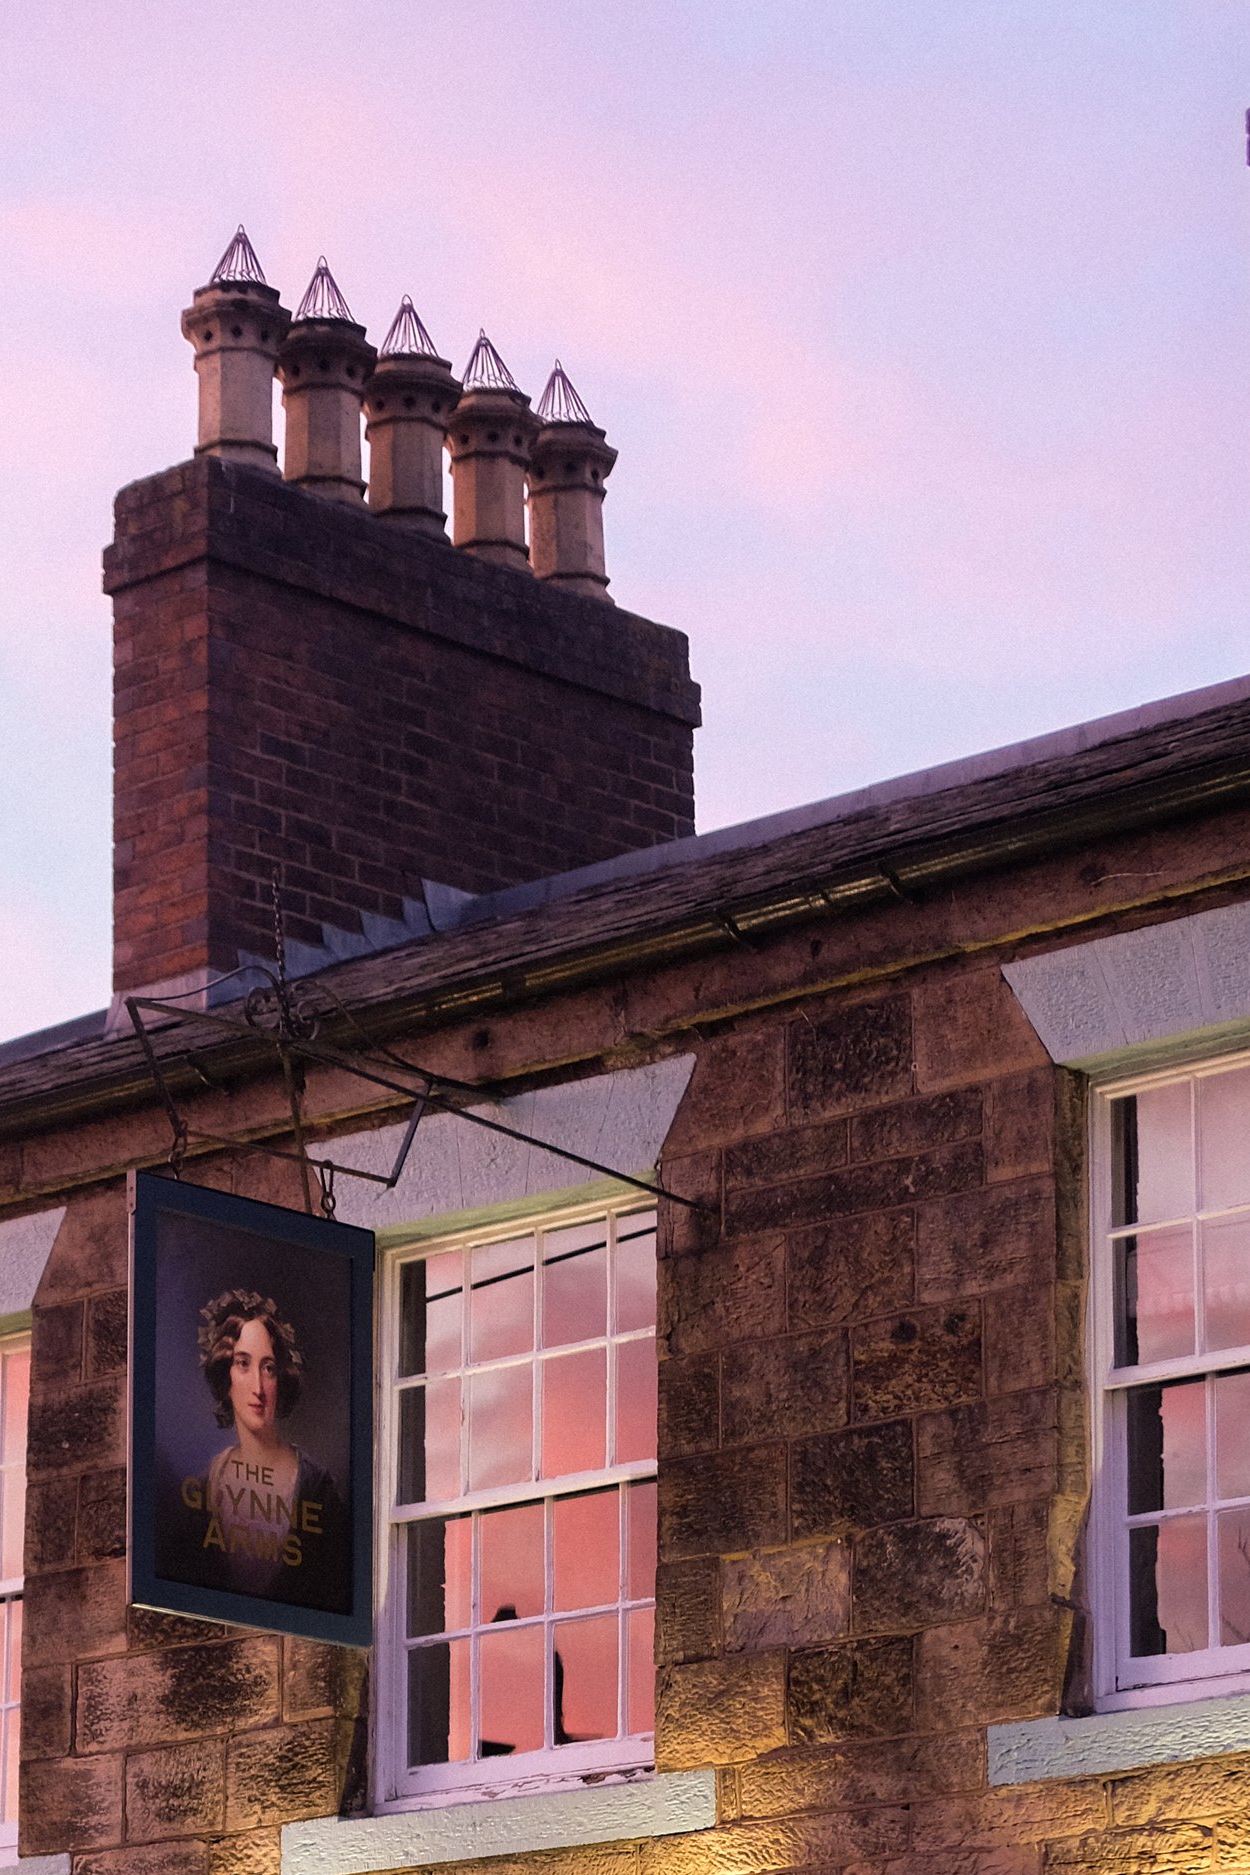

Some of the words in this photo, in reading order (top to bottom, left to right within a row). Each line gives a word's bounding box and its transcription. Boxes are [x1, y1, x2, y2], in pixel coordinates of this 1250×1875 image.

[231, 1460, 275, 1487] THE
[180, 1475, 324, 1535] GLYNNE
[202, 1518, 304, 1568] ARMS
